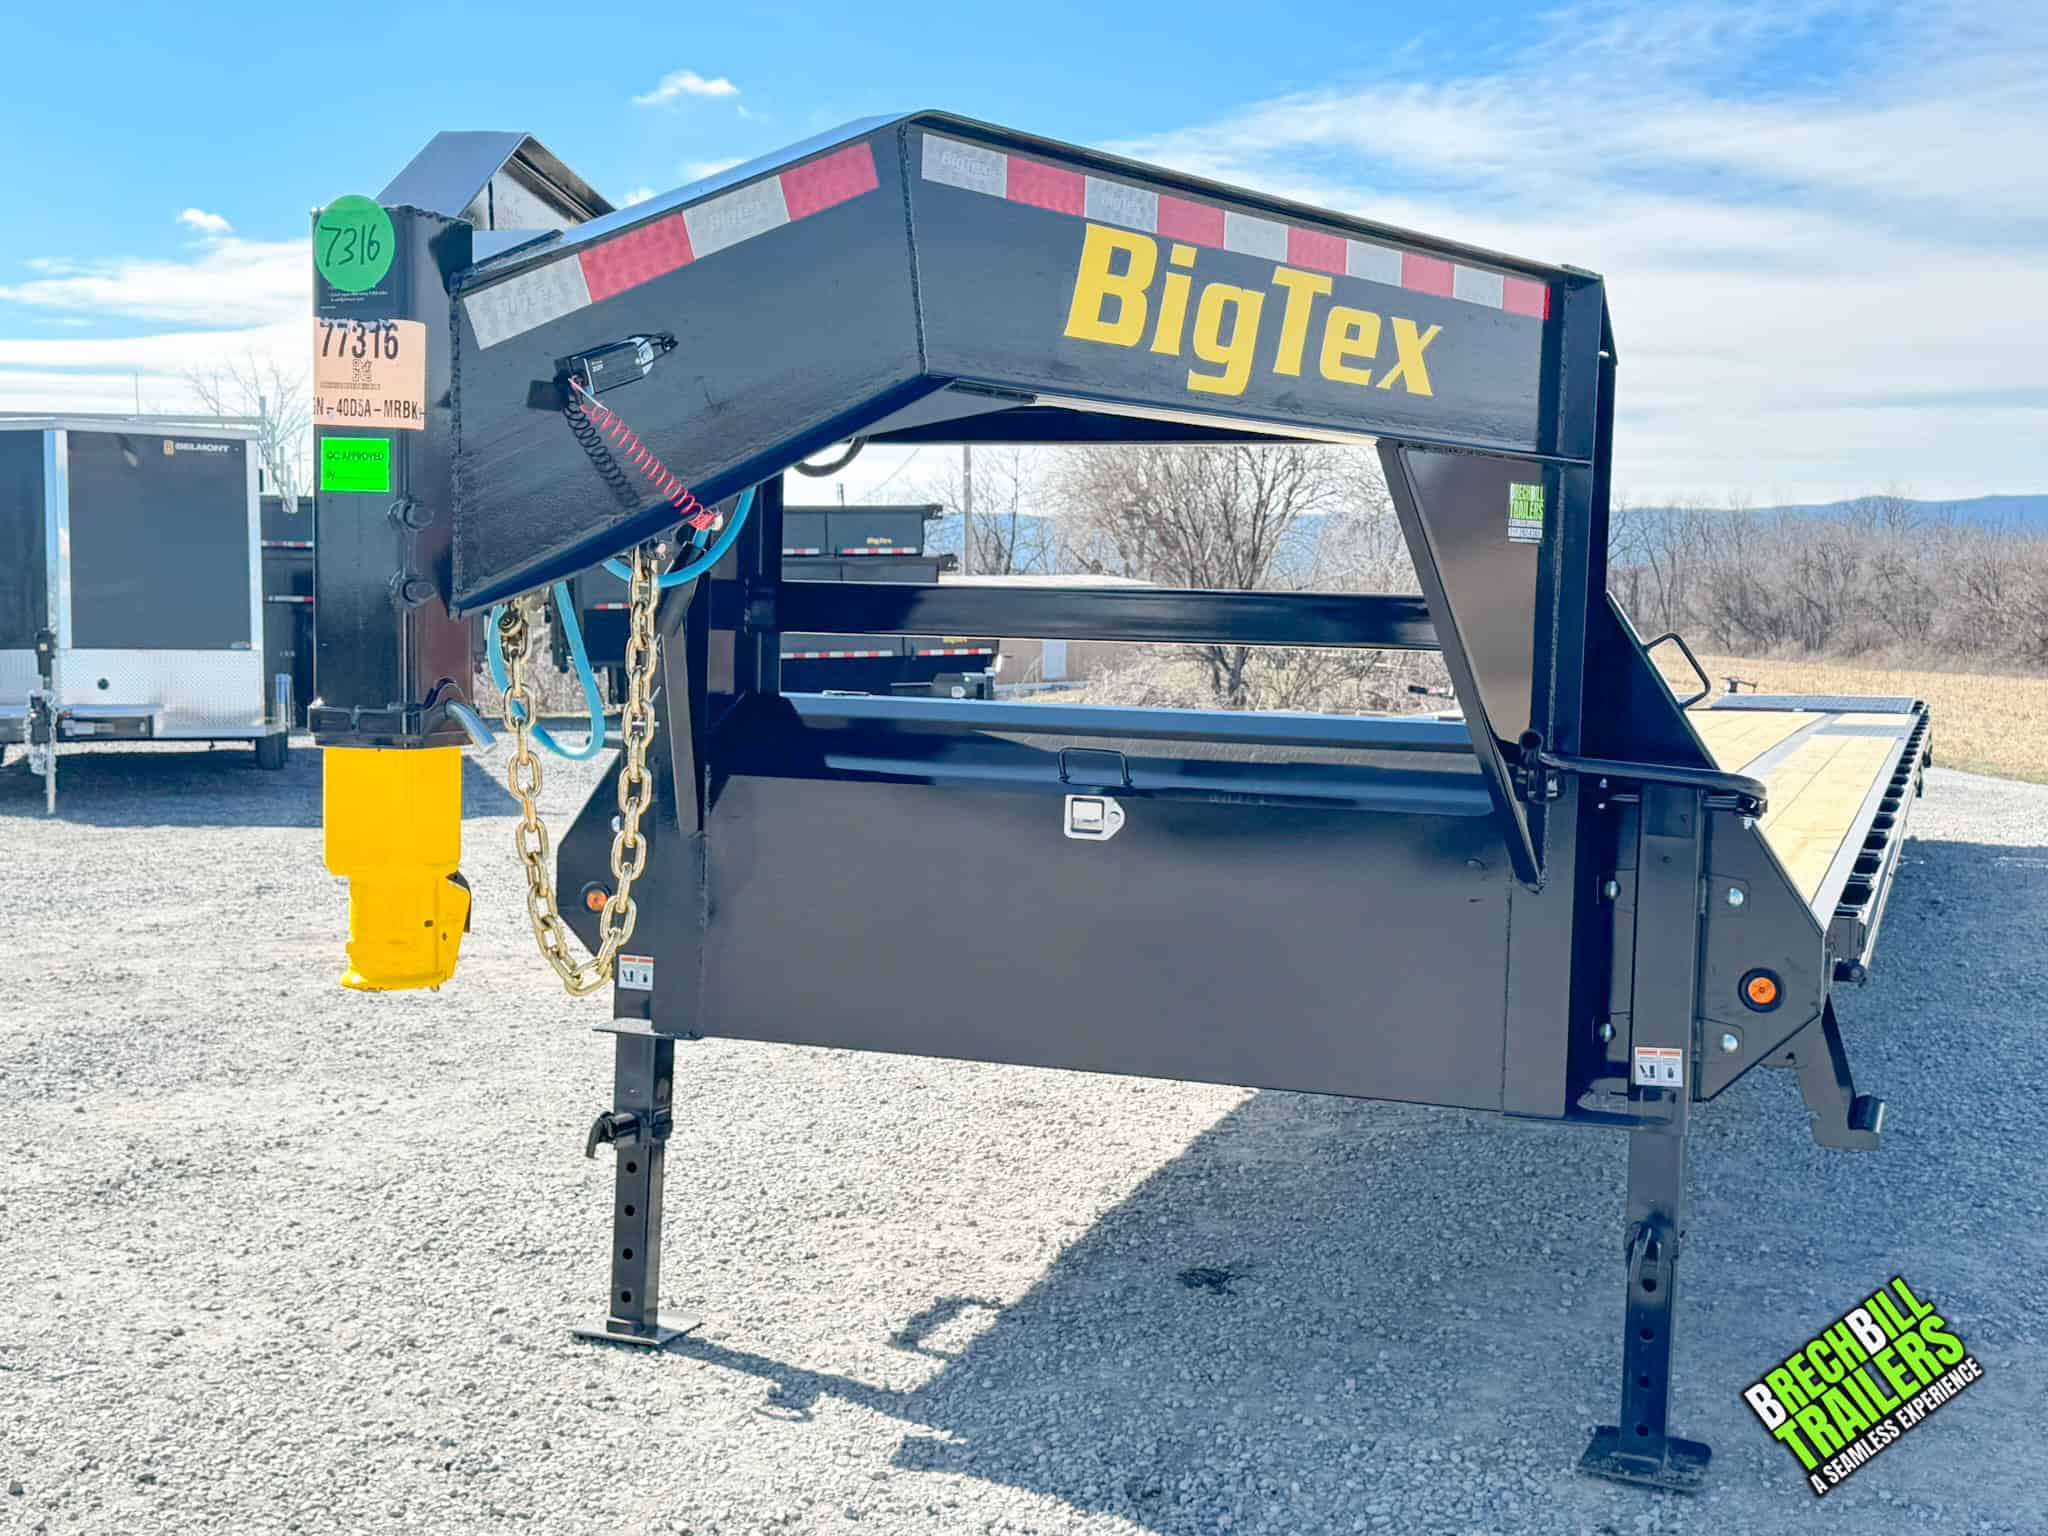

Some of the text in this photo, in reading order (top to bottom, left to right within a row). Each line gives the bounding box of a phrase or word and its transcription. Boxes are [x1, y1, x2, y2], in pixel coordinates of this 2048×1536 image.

[320, 223, 381, 267] 7316
[1064, 223, 1442, 397] BigTex
[320, 320, 399, 360] 77316
[175, 442, 230, 453] BELMONT
